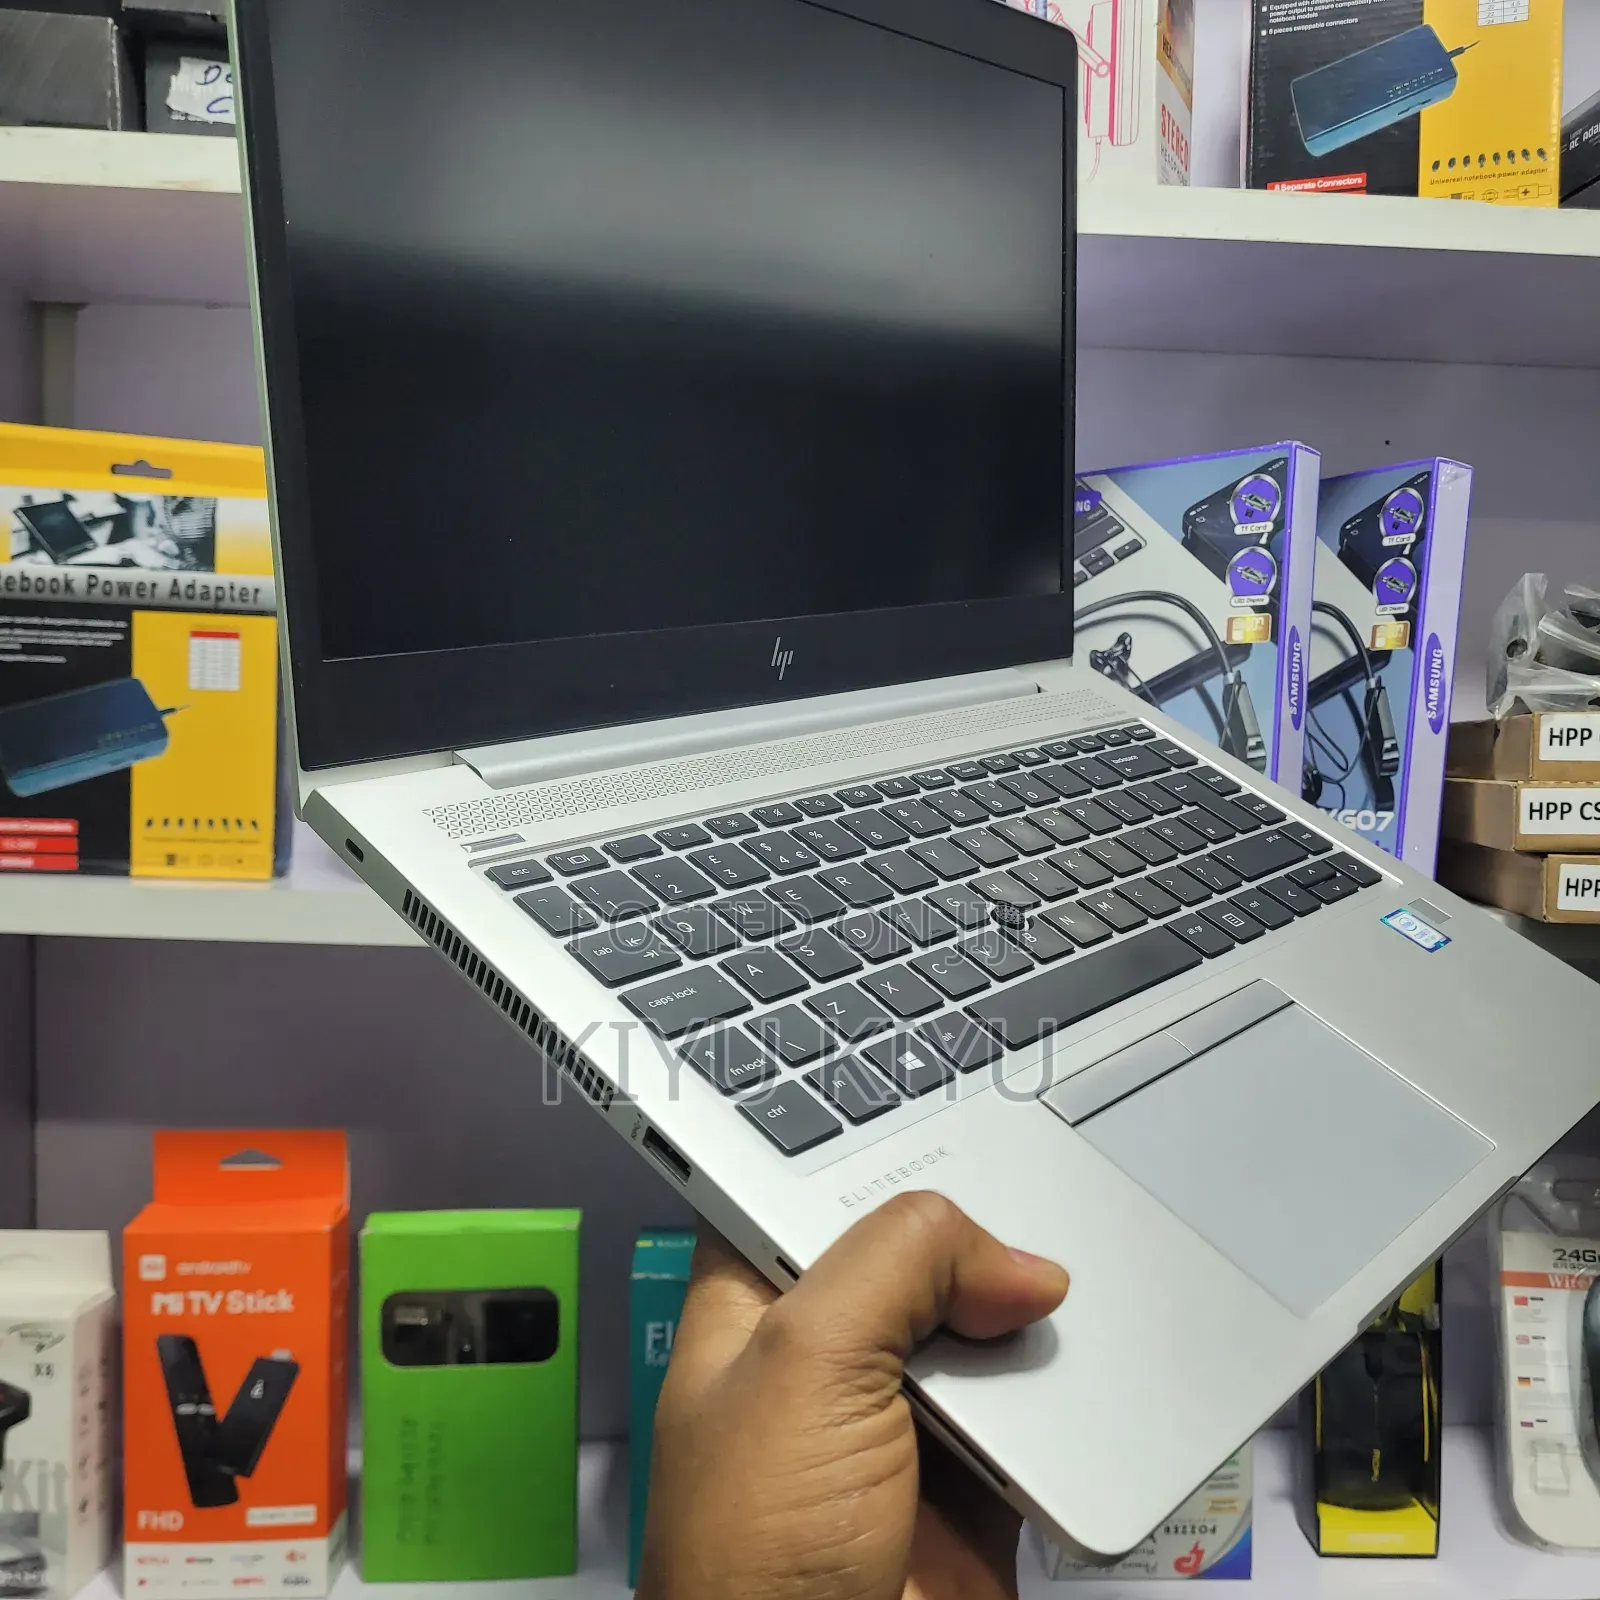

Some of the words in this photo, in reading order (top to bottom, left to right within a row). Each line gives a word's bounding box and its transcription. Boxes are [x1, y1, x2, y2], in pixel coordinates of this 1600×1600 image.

[1569, 137, 1580, 151] AC
[1430, 176, 1463, 185] Universal
[1464, 173, 1497, 182] notebook
[1497, 170, 1520, 179] power
[1281, 181, 1316, 191] Separate
[1317, 177, 1362, 188] Connectors
[86, 573, 158, 599] Power
[168, 578, 261, 610] Adapter
[1290, 642, 1301, 715] SAMSUNG
[1427, 648, 1443, 720] SAMSUNG
[1549, 727, 1593, 747] HPP
[991, 800, 1003, 808] 9
[953, 809, 965, 818] 8
[1075, 808, 1088, 818] P
[1529, 802, 1572, 820] HPP
[912, 820, 925, 829] 7
[1043, 817, 1056, 827] O
[870, 831, 883, 840] 6
[825, 842, 838, 852] 5
[966, 838, 981, 848] U
[925, 850, 940, 860] Y
[1098, 849, 1112, 859] L
[778, 856, 790, 865] 4
[1064, 859, 1079, 870] K
[511, 867, 531, 876] esc
[881, 862, 896, 873] T
[723, 868, 738, 879] 3
[1028, 872, 1039, 881] J
[834, 876, 853, 887] R
[667, 883, 683, 895] 2
[986, 882, 1003, 893] H
[785, 889, 802, 901] E
[946, 896, 961, 907] G
[1096, 901, 1113, 911] M
[732, 902, 753, 917] W
[1059, 915, 1075, 926] N
[676, 921, 695, 932] Q
[851, 927, 867, 939] D
[1022, 931, 1037, 943] B
[593, 946, 612, 957] tab
[800, 945, 815, 957] S
[975, 946, 991, 957] V
[746, 964, 764, 977] A
[931, 963, 948, 974] C
[880, 981, 899, 994] X
[648, 993, 673, 1009] caps
[673, 986, 697, 1000] lock
[827, 1001, 846, 1015] Z
[942, 1031, 956, 1042] alt
[730, 1064, 745, 1077] fn
[745, 1056, 768, 1072] lock
[767, 1104, 787, 1119] ctrl
[839, 1145, 949, 1208] ELITEBOOK
[187, 1290, 225, 1315] TV
[226, 1288, 295, 1314] Stick
[137, 1510, 184, 1531] FHD
